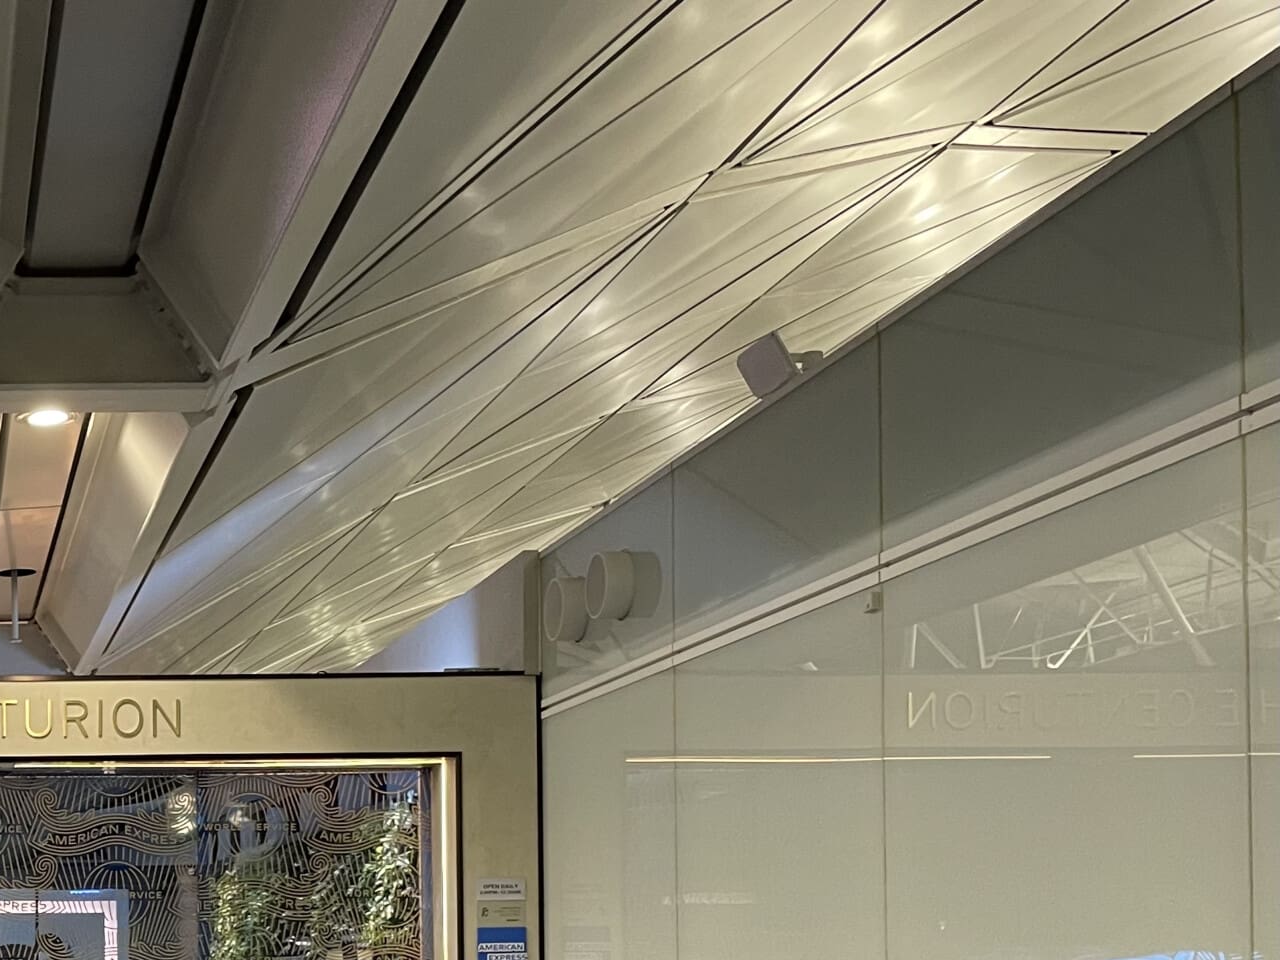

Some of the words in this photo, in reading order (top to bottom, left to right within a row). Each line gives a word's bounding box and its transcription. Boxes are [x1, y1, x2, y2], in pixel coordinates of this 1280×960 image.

[45, 825, 120, 846] AMERICAN
[124, 825, 187, 845] EXPRESS
[129, 891, 163, 900] RVICE
[478, 943, 524, 951] AMERICAN
